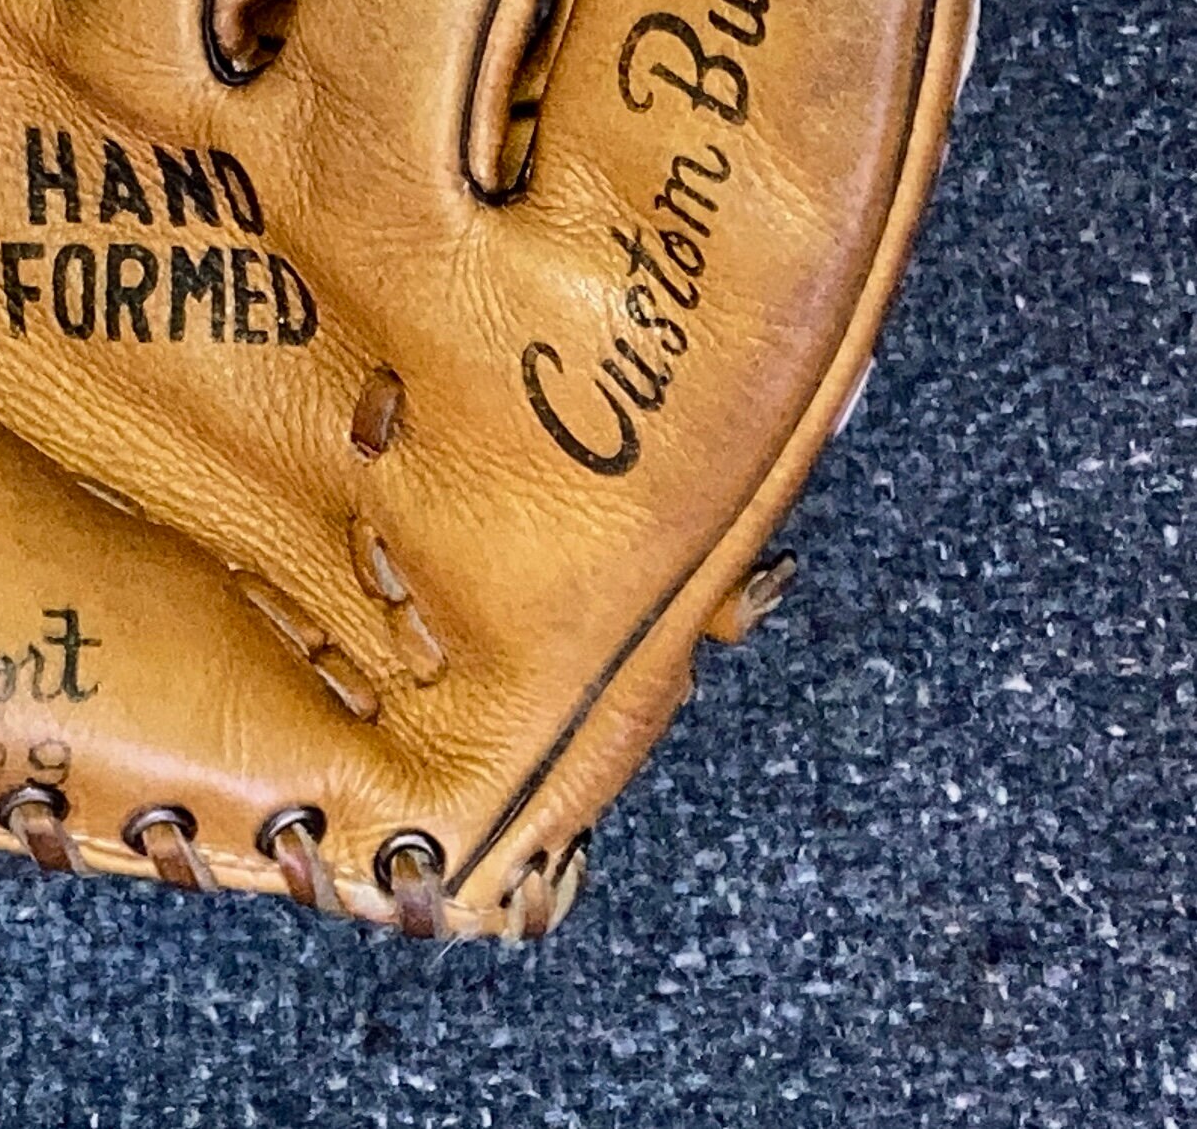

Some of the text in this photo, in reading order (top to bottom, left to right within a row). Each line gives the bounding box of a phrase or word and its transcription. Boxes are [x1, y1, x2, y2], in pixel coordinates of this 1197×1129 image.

[24, 126, 266, 237] HAND
[0, 241, 320, 347] FORMED
[521, 143, 731, 478] Custom
